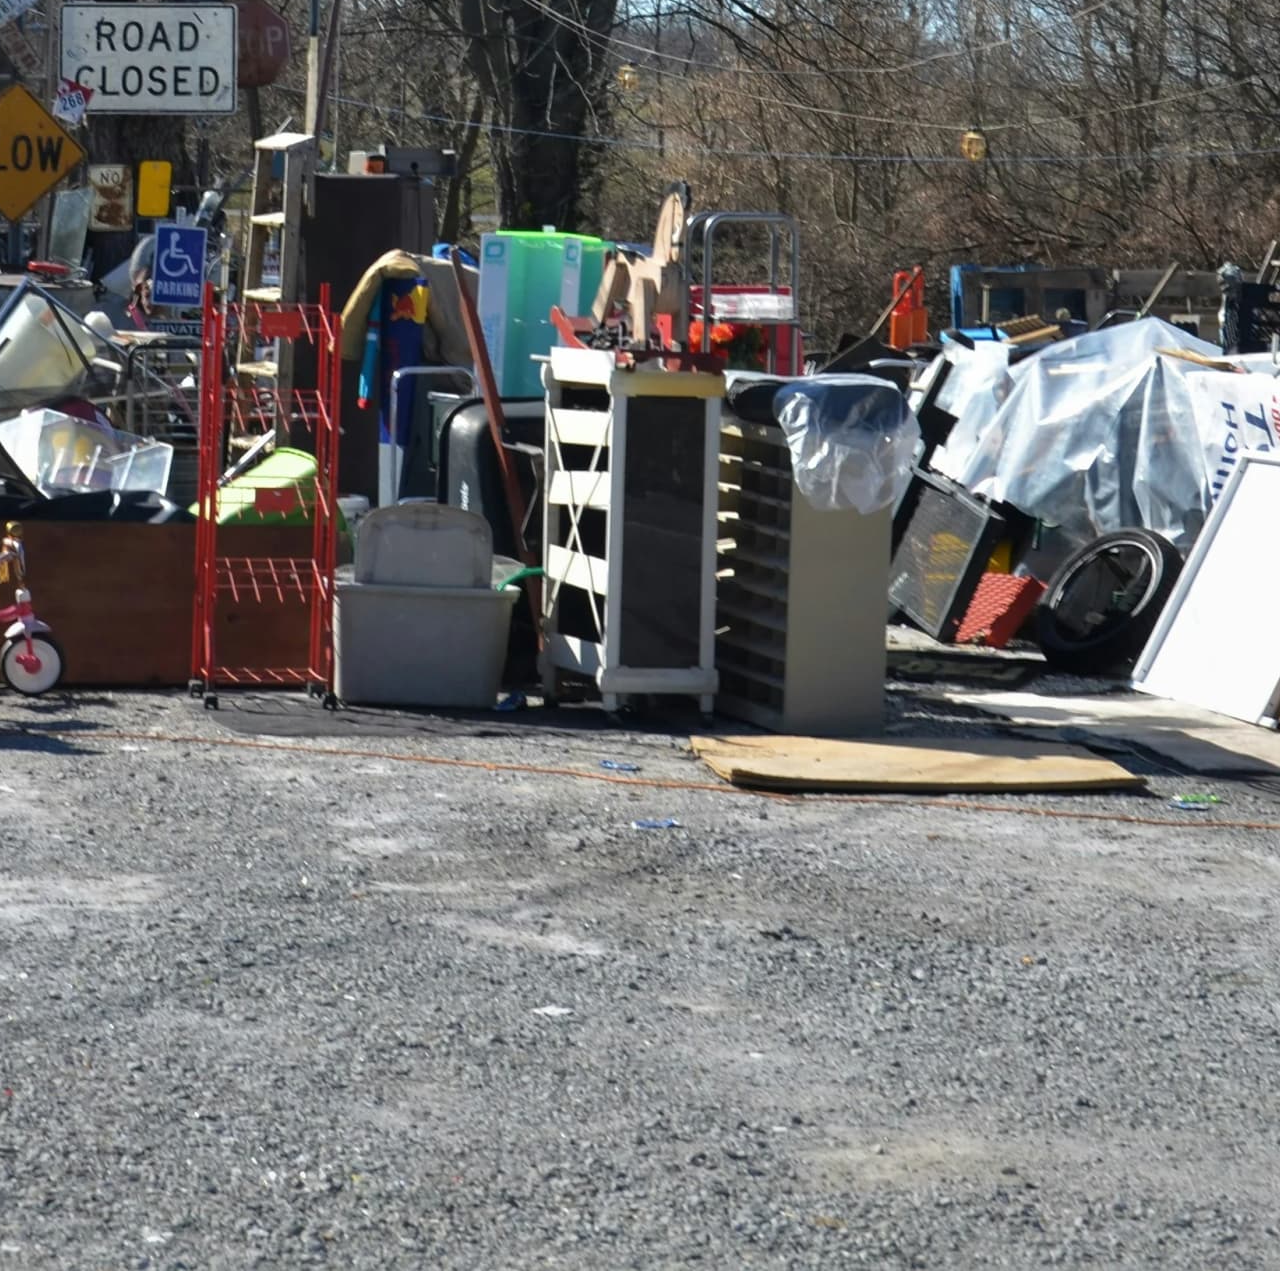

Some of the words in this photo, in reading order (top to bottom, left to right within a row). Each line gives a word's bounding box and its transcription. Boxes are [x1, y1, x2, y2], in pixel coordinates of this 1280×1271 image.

[96, 20, 201, 53] ROAD
[75, 66, 220, 97] CLOSED
[100, 171, 121, 185] NO
[156, 280, 200, 297] PARKING
